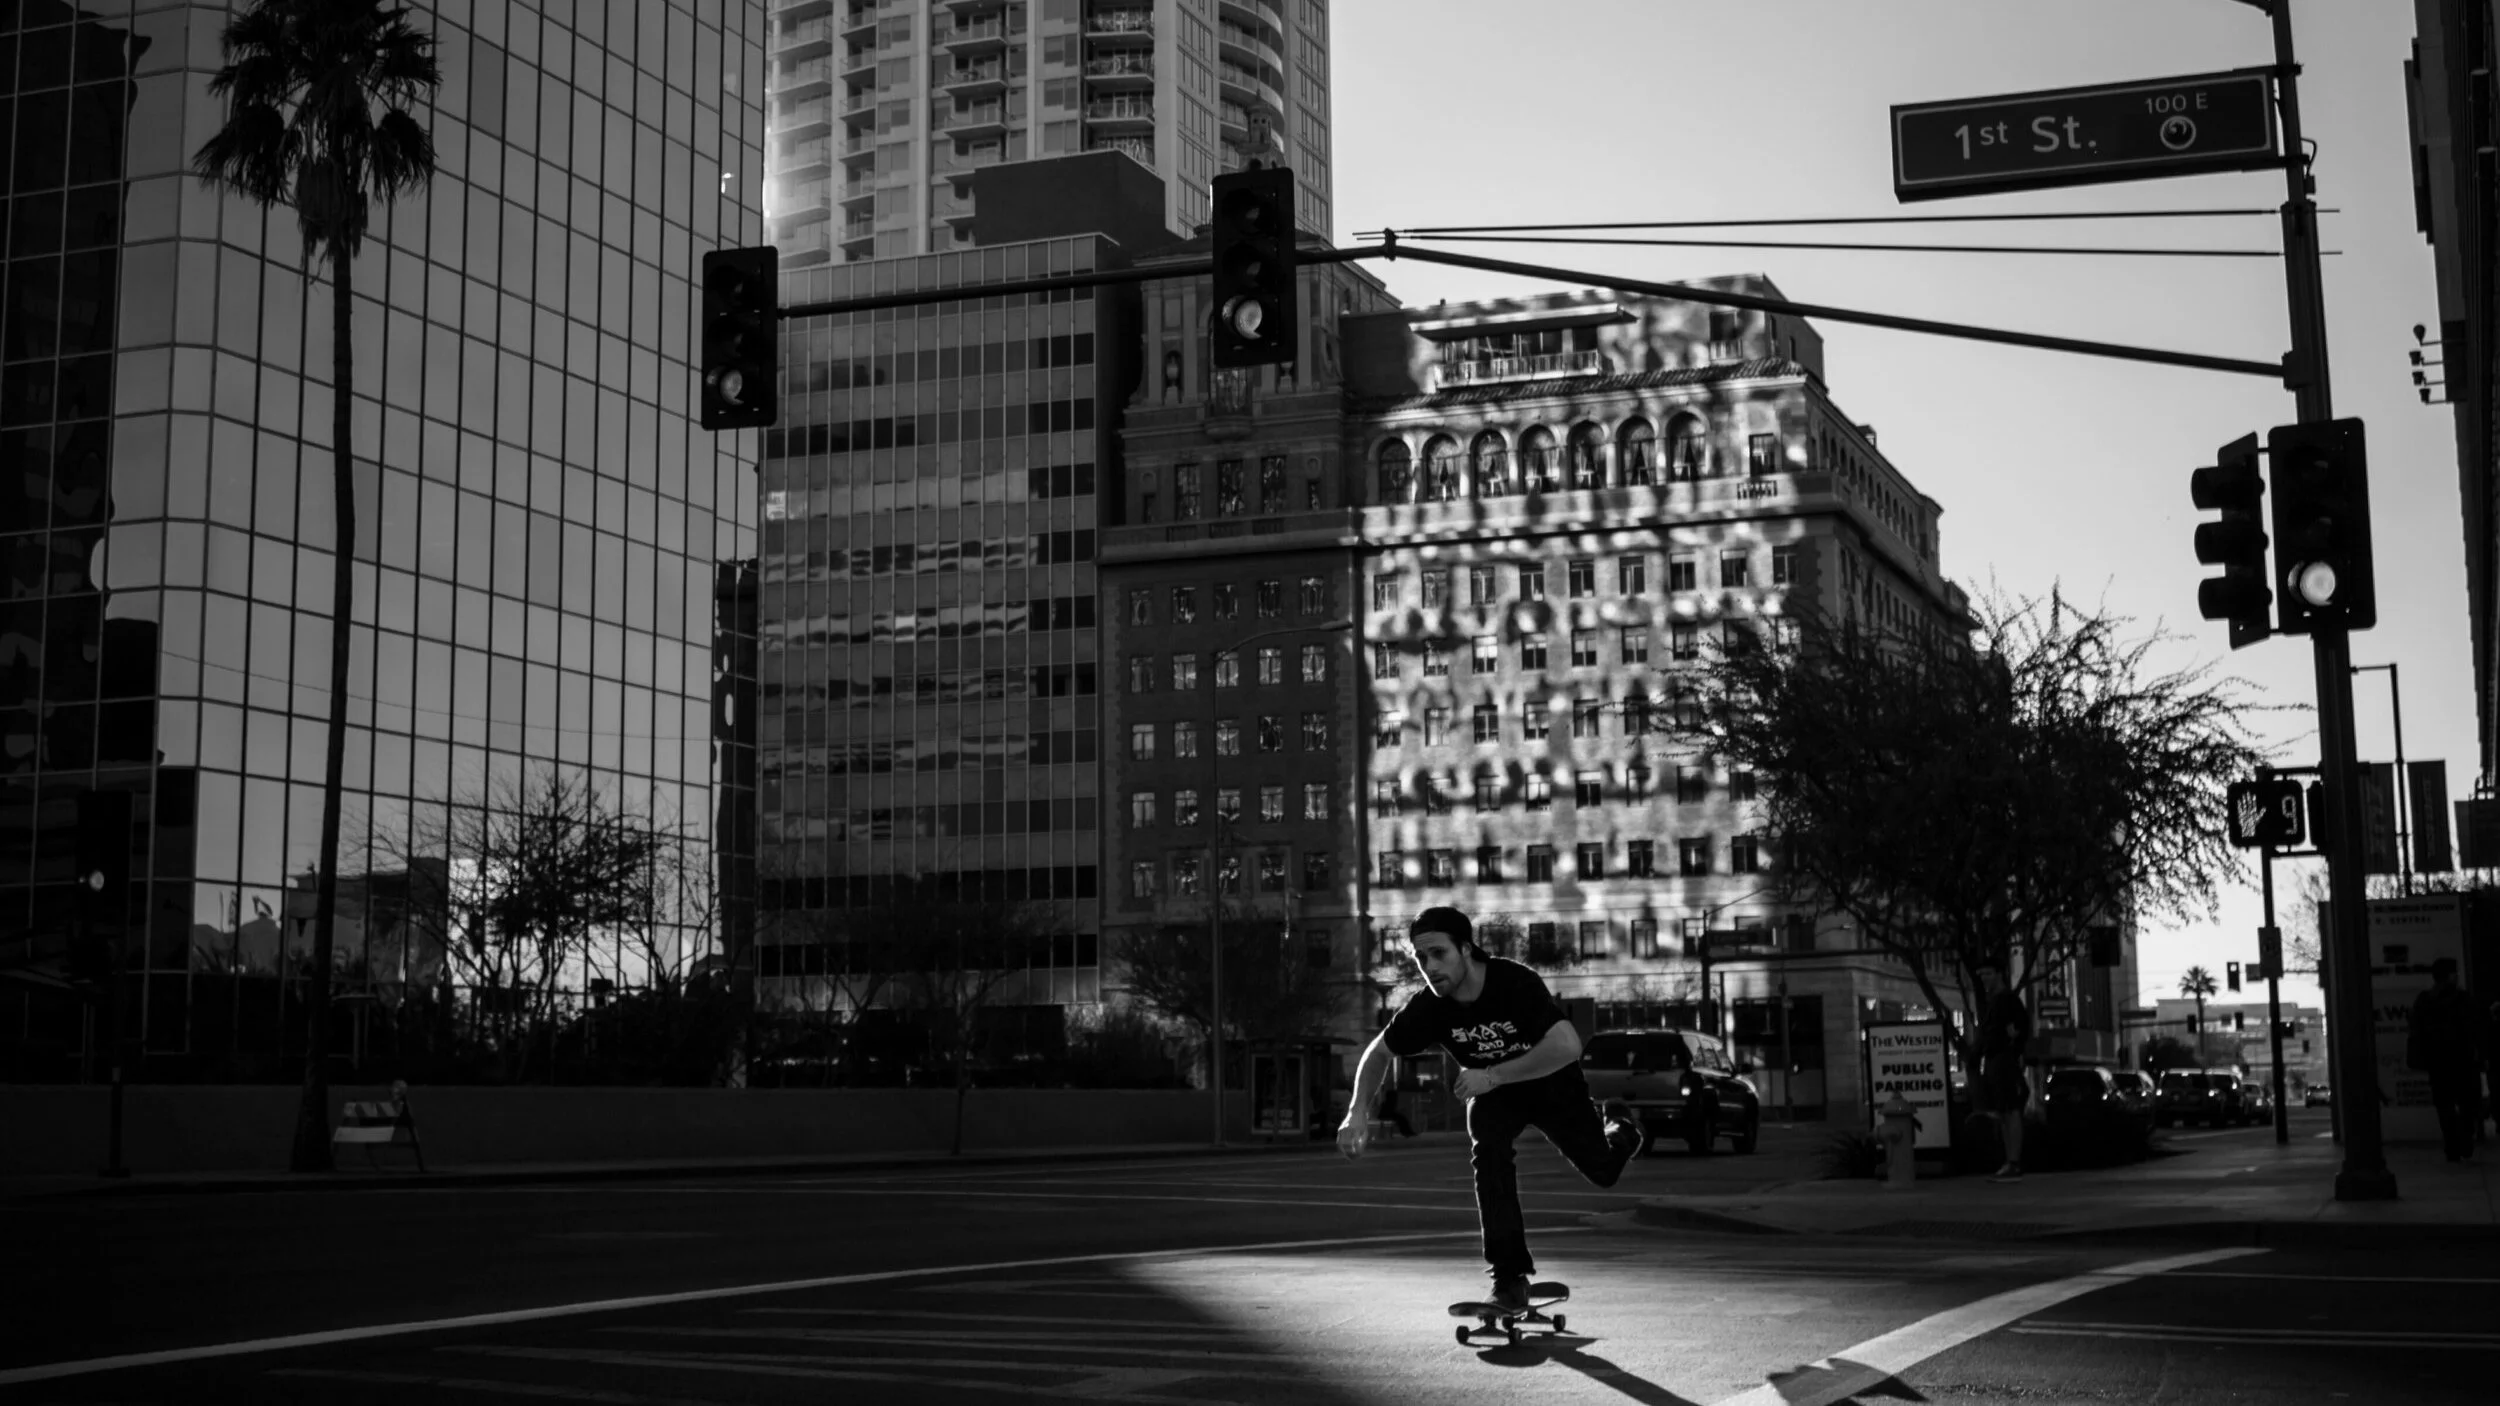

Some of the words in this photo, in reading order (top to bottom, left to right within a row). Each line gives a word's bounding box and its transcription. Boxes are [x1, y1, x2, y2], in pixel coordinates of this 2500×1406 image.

[2144, 93, 2187, 115] 100
[2195, 92, 2209, 110] E
[1954, 121, 2009, 161] 1st
[2031, 115, 2097, 153] St.
[2281, 794, 2298, 835] 9
[1870, 1035, 1893, 1048] THE
[1894, 1034, 1942, 1046] WESTIN
[1881, 1062, 1934, 1076] PUBLIC
[1875, 1078, 1944, 1092] PARKING
